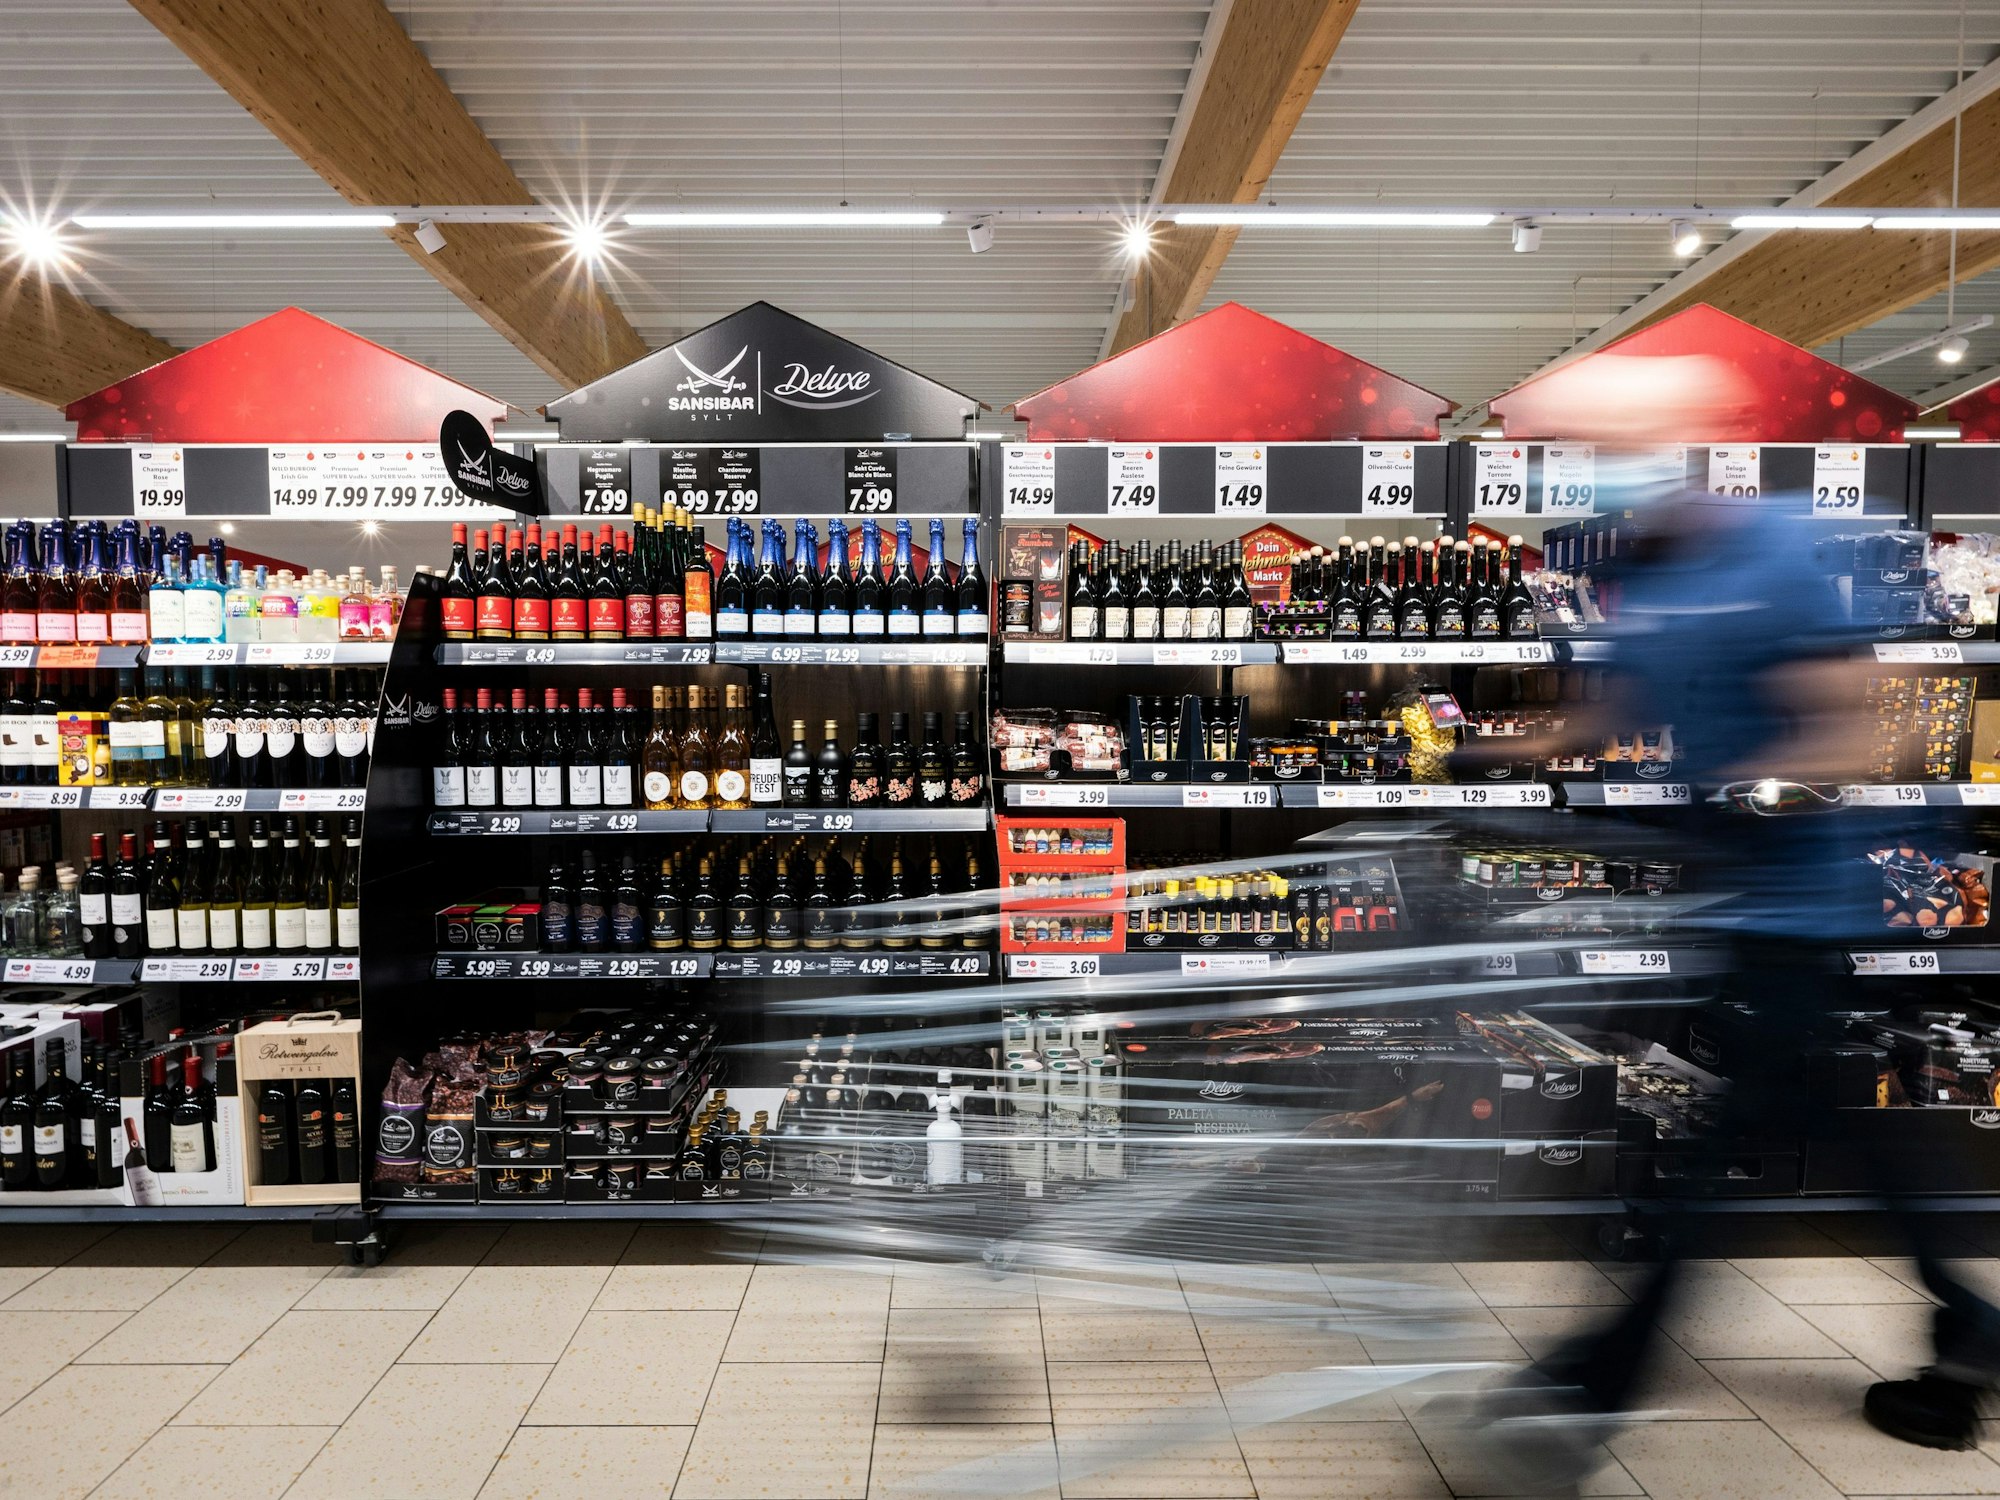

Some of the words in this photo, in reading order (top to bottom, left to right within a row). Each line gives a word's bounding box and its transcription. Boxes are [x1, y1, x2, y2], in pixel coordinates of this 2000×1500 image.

[774, 362, 871, 398] Deluxe
[668, 396, 754, 411] SANSIBAR
[587, 466, 622, 474] Negroamaro
[673, 466, 697, 474] Riesling
[718, 466, 752, 474] Chardonnay
[457, 470, 491, 488] SANSIBAR
[496, 466, 529, 490] Deluxe
[139, 489, 184, 506] 19.99
[274, 489, 318, 506] 14.99
[325, 486, 368, 507] 7.99
[374, 486, 417, 507] 7.99
[584, 489, 628, 512] 7.99
[715, 489, 758, 512] 7.99
[849, 488, 893, 511] 7.99
[1009, 487, 1054, 505] 14.99
[1111, 485, 1156, 507] 7.49
[1219, 485, 1262, 506] 1.49
[1368, 485, 1413, 505] 4.99
[1479, 484, 1521, 506] 1.79
[1549, 484, 1592, 507] 1.99
[1815, 486, 1860, 508] 2.59
[1256, 541, 1280, 552] Dein
[1253, 571, 1283, 581] Markt
[1885, 570, 1905, 580] Deluxe
[1, 649, 29, 661] 5.99
[206, 649, 234, 661] 2.99
[303, 648, 331, 660] 3.99
[525, 649, 556, 662] 8.49
[681, 648, 710, 662] 7.99
[771, 647, 801, 661] 6.99
[825, 648, 860, 662] 12.99
[932, 648, 966, 662] 14.99
[1088, 648, 1114, 662] 1.79
[1210, 650, 1237, 661] 2.99
[1342, 648, 1367, 660] 1.49
[1400, 646, 1426, 658] 2.99
[1516, 646, 1541, 659] 1.19
[1931, 647, 1958, 660] 3.99
[413, 701, 439, 718] Deluxe
[383, 717, 410, 725] SANSIBAR
[1278, 766, 1298, 775] Deluxe
[1639, 764, 1668, 774] Deluxe
[754, 783, 775, 793] FEST
[1661, 786, 1687, 799] 3.99
[1895, 787, 1921, 800] 1.99
[50, 793, 78, 805] 8.99
[118, 793, 143, 805] 9.99
[214, 795, 242, 807] 2.99
[337, 794, 364, 807] 2.99
[1078, 791, 1105, 803] 3.99
[1242, 791, 1267, 804] 1.19
[1376, 791, 1402, 804] 1.09
[1461, 789, 1487, 803] 1.29
[1520, 789, 1546, 802] 3.99
[490, 817, 521, 832] 2.99
[607, 814, 638, 829] 4.99
[822, 814, 853, 829] 8.99
[1542, 888, 1561, 896] Deluxe
[670, 959, 698, 975] 1.99
[771, 959, 801, 974] 2.99
[859, 958, 889, 973] 4.99
[949, 957, 979, 973] 4.49
[1069, 960, 1096, 974] 3.69
[1486, 956, 1512, 969] 2.99
[1639, 953, 1665, 967] 2.99
[1909, 955, 1935, 968] 6.99
[63, 965, 90, 979] 4.99
[199, 963, 227, 977] 2.99
[292, 963, 320, 977] 5.79
[465, 960, 496, 976] 5.99
[520, 960, 550, 976] 5.99
[608, 960, 639, 976] 2.99
[1349, 1029, 1387, 1037] Deluxe
[259, 1043, 339, 1063] Rotweingalerie
[1378, 1053, 1418, 1061] Deluxe
[1199, 1080, 1244, 1096] Deluxe
[1545, 1082, 1578, 1094] Deluxe
[1168, 1108, 1213, 1120] PALETA
[1194, 1122, 1251, 1134] RESERVA
[1545, 1148, 1578, 1160] Deluxe
